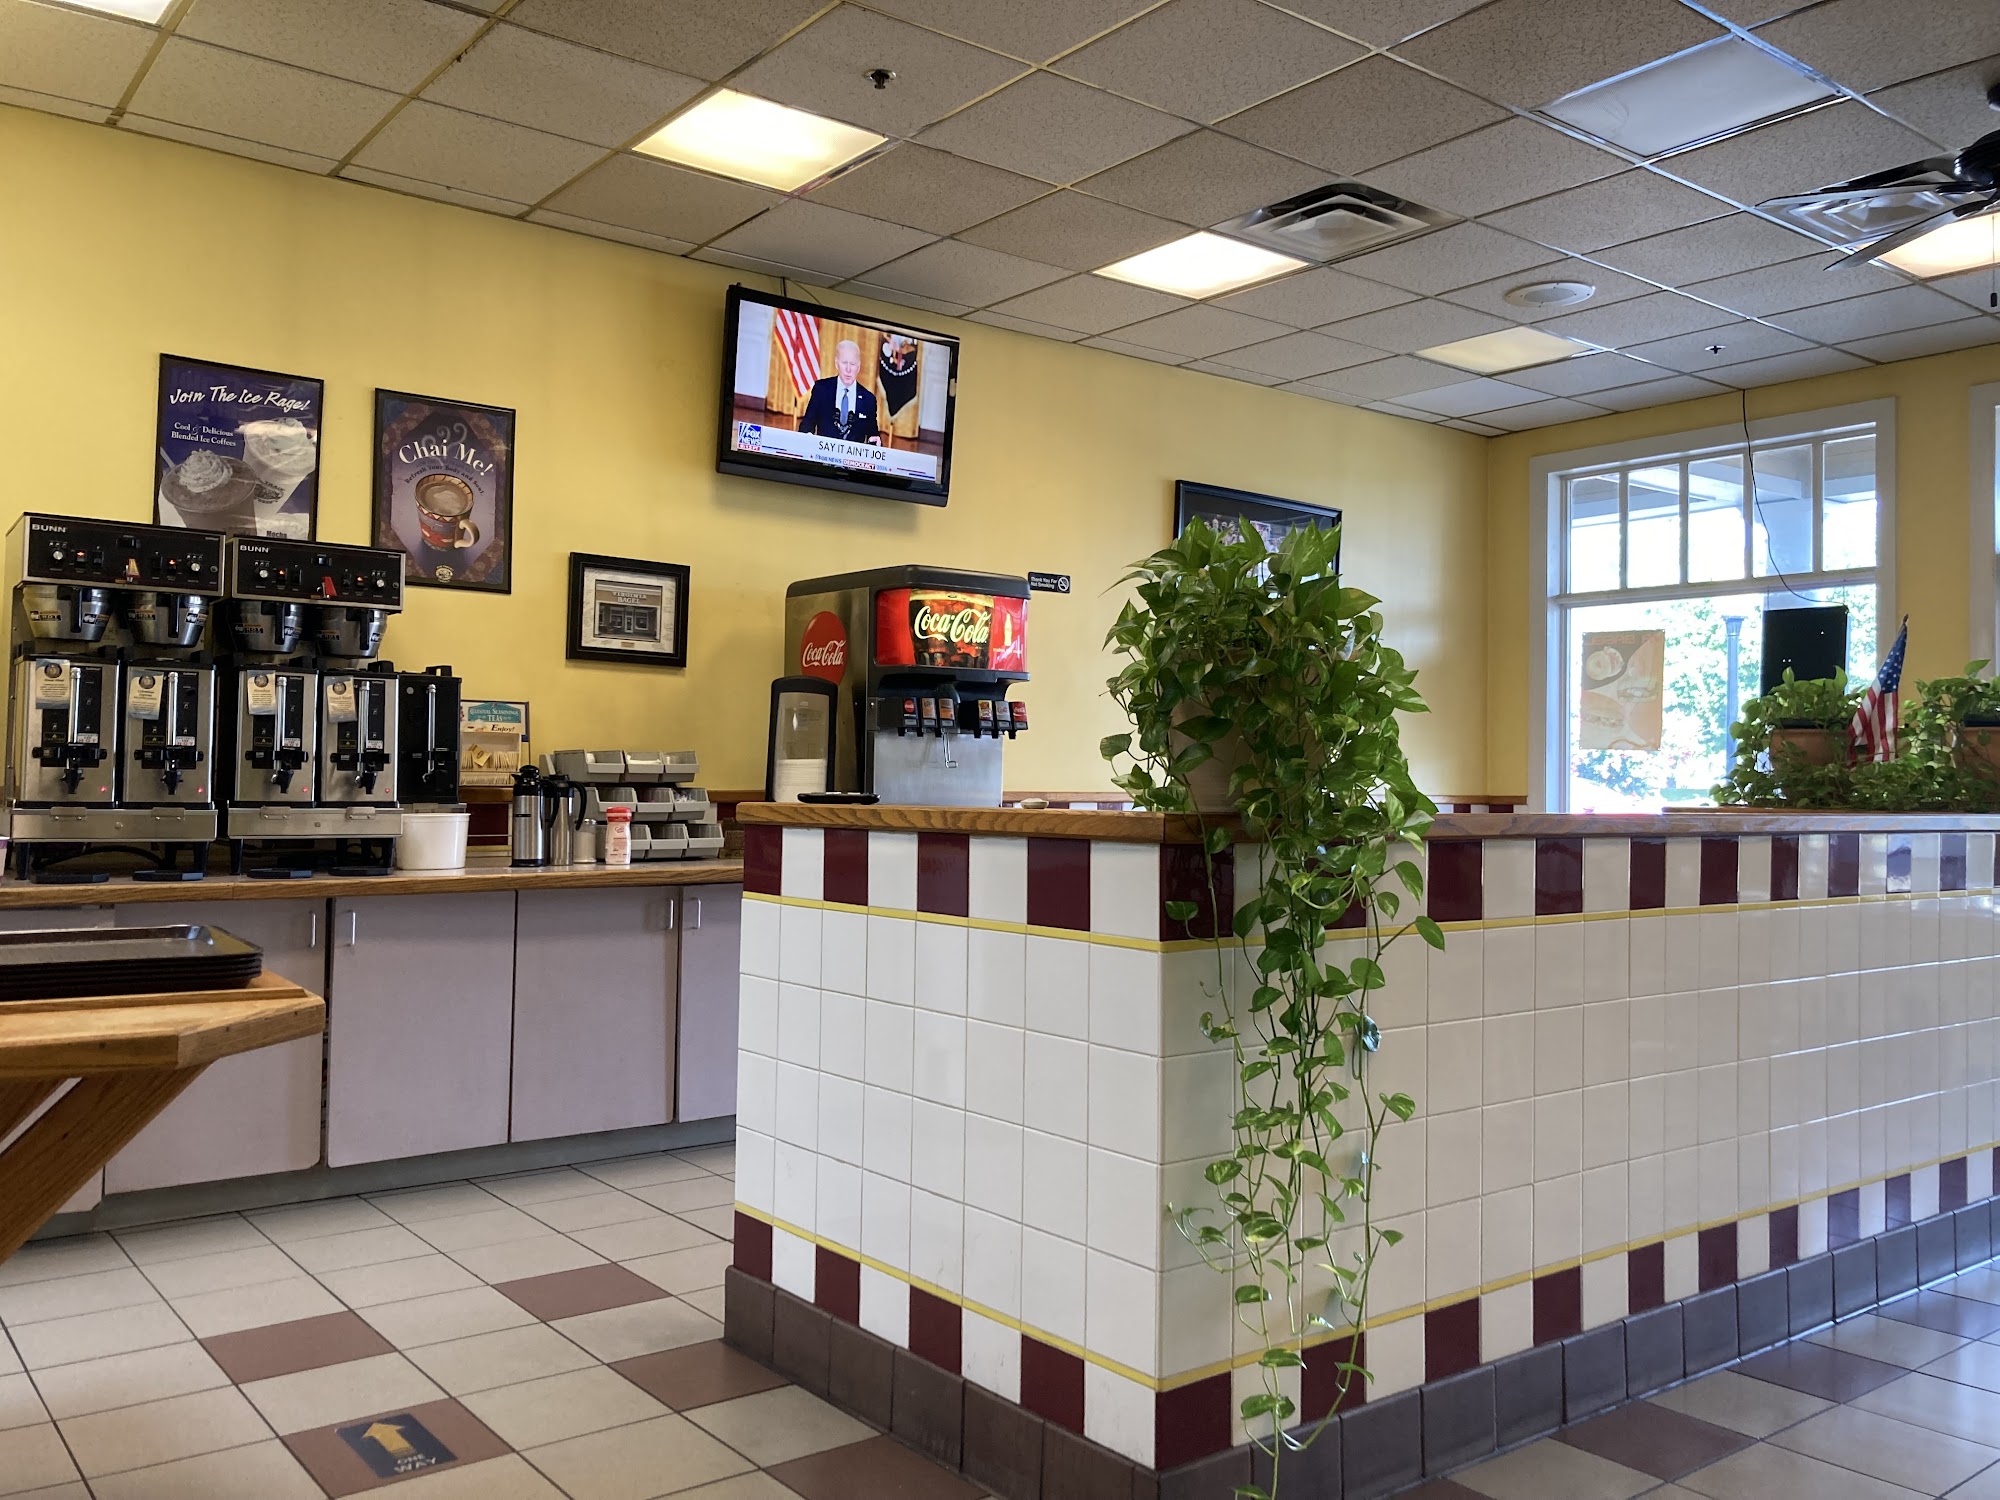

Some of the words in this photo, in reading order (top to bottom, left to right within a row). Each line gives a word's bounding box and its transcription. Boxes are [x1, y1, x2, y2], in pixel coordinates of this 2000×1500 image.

[170, 388, 206, 404] Join
[209, 385, 237, 402] The
[238, 388, 263, 404] Ice
[264, 391, 311, 413] Rage!
[174, 421, 191, 431] Cool
[202, 426, 234, 437] Delicious
[746, 429, 761, 439] FOX
[171, 430, 199, 442] Blended
[200, 434, 211, 443] Ice
[211, 436, 237, 447] Coffees
[742, 437, 761, 446] NEWS
[398, 438, 448, 464] Chai
[453, 442, 494, 476] Me!
[818, 440, 836, 452] SAY
[837, 444, 845, 454] IT
[846, 446, 870, 458] AIN'T
[870, 450, 887, 461] JOE
[843, 459, 876, 470] DEMOCRACY
[404, 467, 428, 484] Refresh
[31, 523, 66, 533] BUNN
[239, 544, 269, 554] BUNN
[1038, 582, 1055, 590] Smoking
[914, 605, 992, 644] Coca-Cola
[802, 640, 847, 668] Coca-Cola
[487, 714, 503, 722] TEAS
[491, 723, 516, 733] Enjoy!
